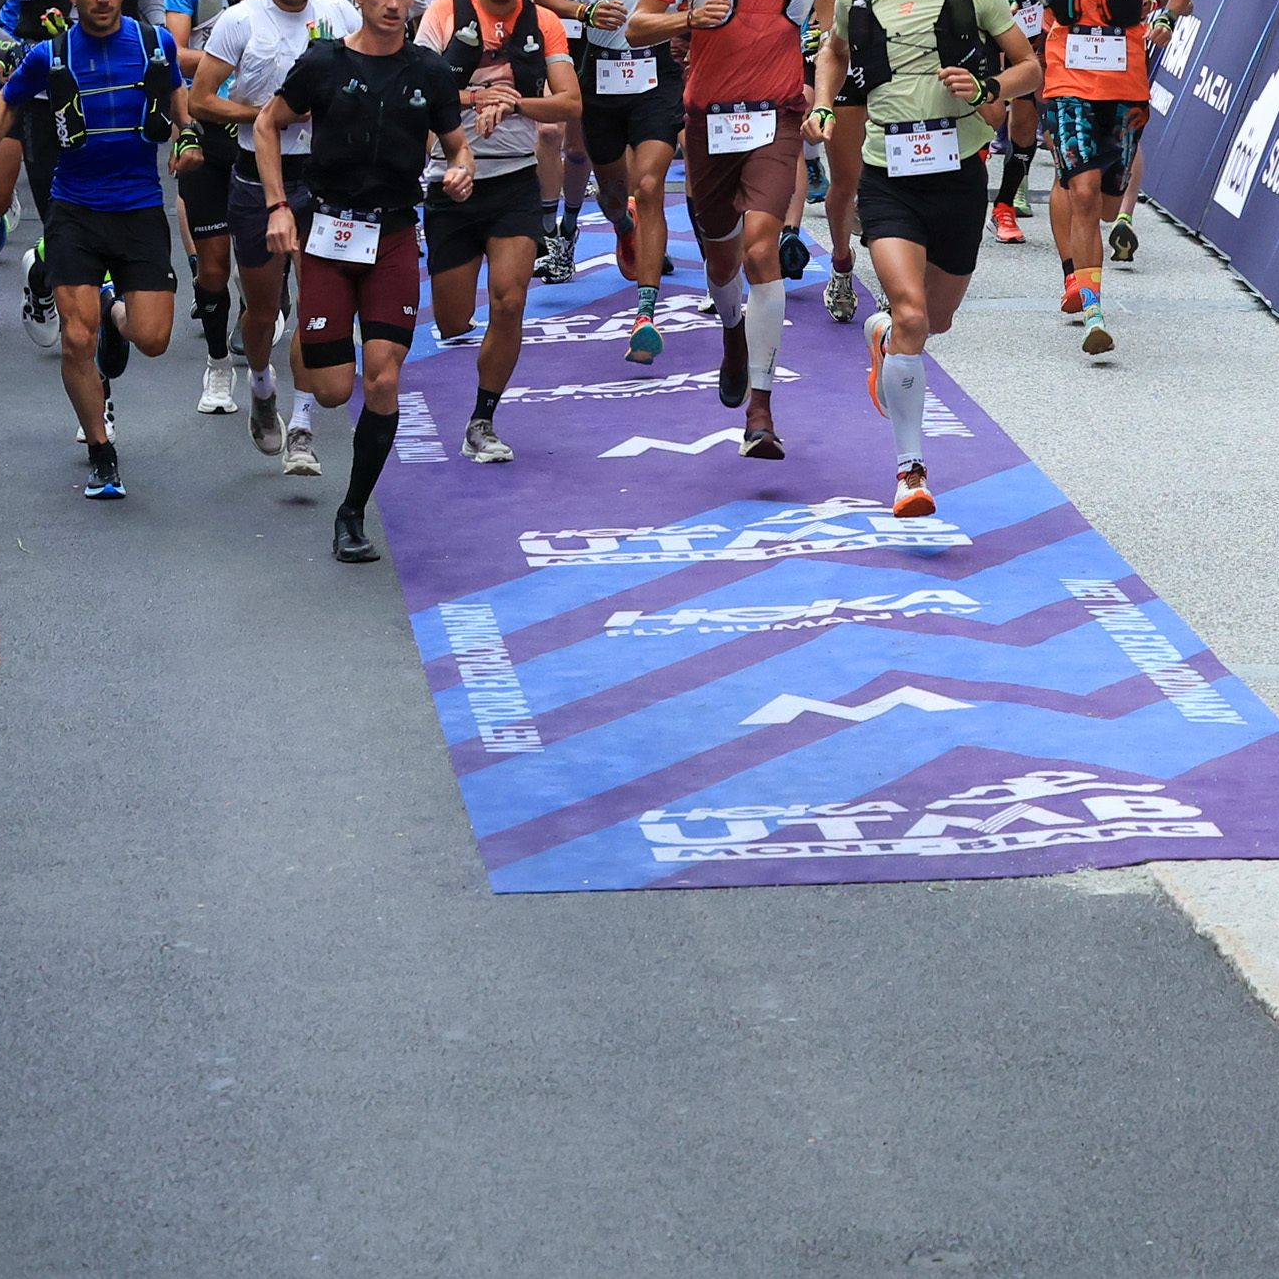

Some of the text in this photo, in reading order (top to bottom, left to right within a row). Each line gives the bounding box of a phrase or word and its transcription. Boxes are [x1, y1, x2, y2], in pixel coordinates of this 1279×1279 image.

[1023, 13, 1038, 24] 167
[622, 69, 634, 78] 12
[1193, 65, 1232, 115] DACIA
[54, 111, 68, 148] HOKA
[734, 123, 750, 134] 50
[914, 144, 931, 155] 36
[334, 230, 352, 241] 39
[518, 524, 731, 540] HOKA
[518, 516, 960, 555] UTMB
[604, 589, 982, 628] HOKA
[606, 606, 982, 638] FLY HUMAN FLY
[640, 795, 1202, 846] UTMB
[641, 800, 909, 822] HOKA
